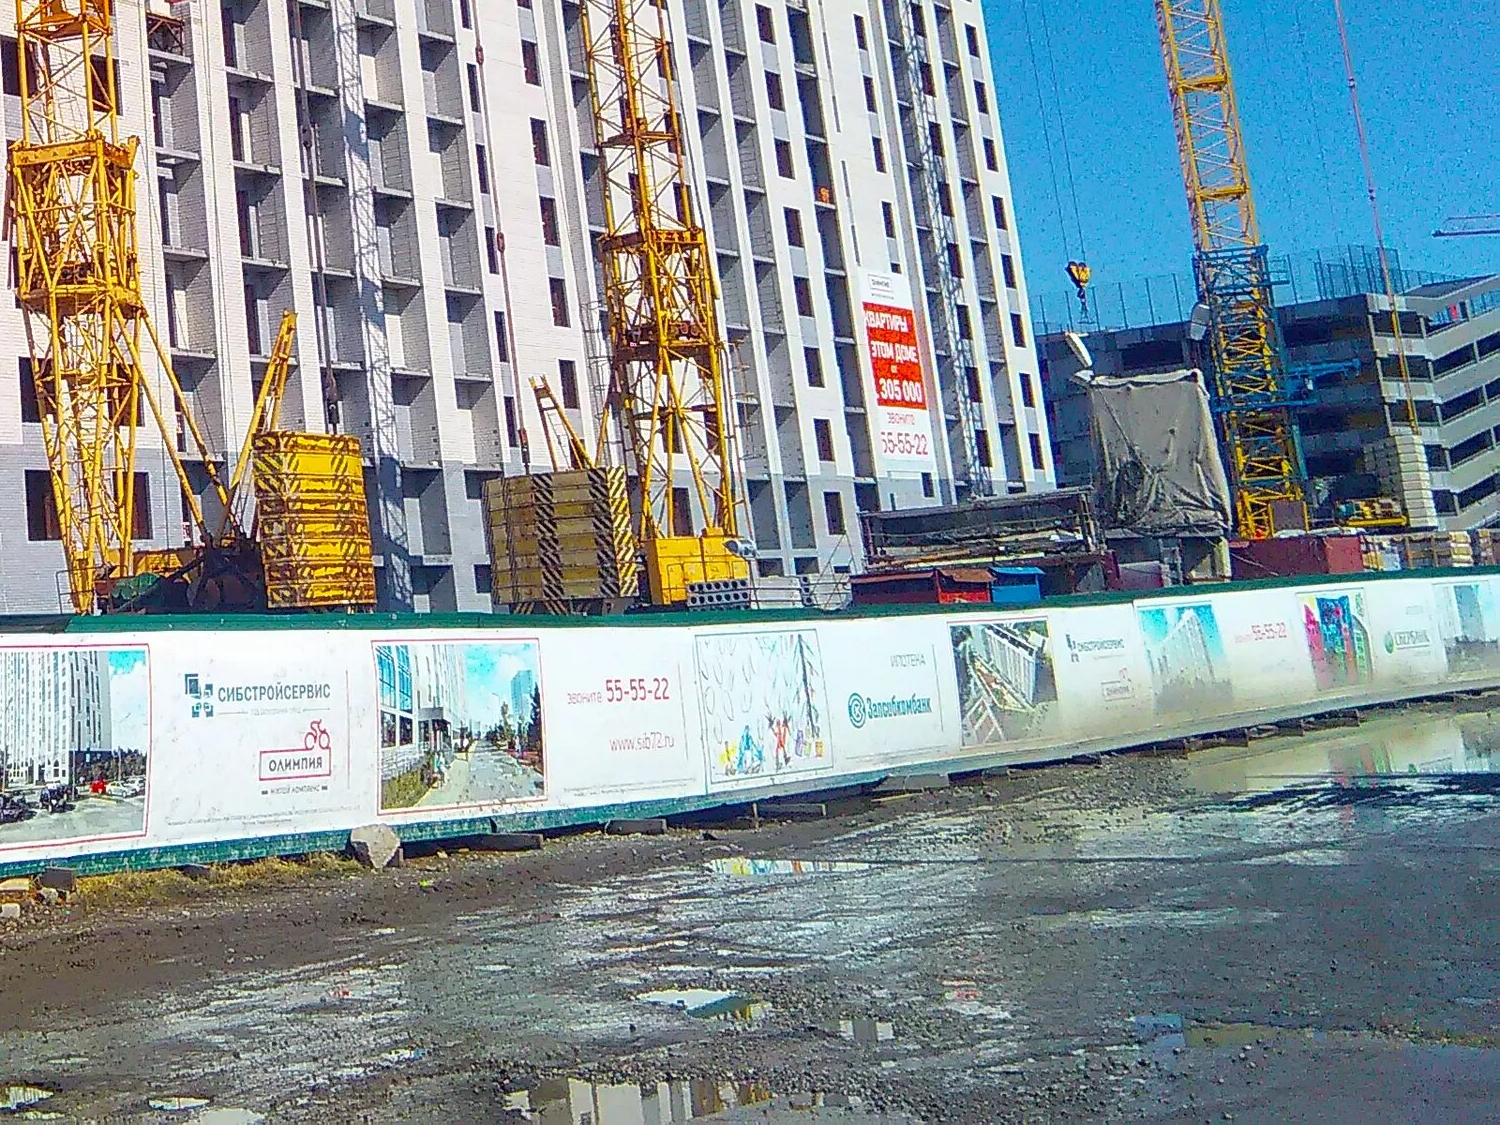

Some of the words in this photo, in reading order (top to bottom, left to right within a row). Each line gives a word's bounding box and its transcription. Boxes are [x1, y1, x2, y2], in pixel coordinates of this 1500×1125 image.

[871, 340, 895, 360] ЭТОМ
[895, 343, 919, 364] ДОМЕ
[879, 378, 902, 401] 305
[902, 379, 923, 403] 000
[218, 682, 331, 703] СИБСТРОЙСЕРВИС
[605, 677, 670, 703] 55-55-22
[609, 732, 675, 751] www.sib72.ru
[268, 756, 323, 773] ОЛИМПИЯ
